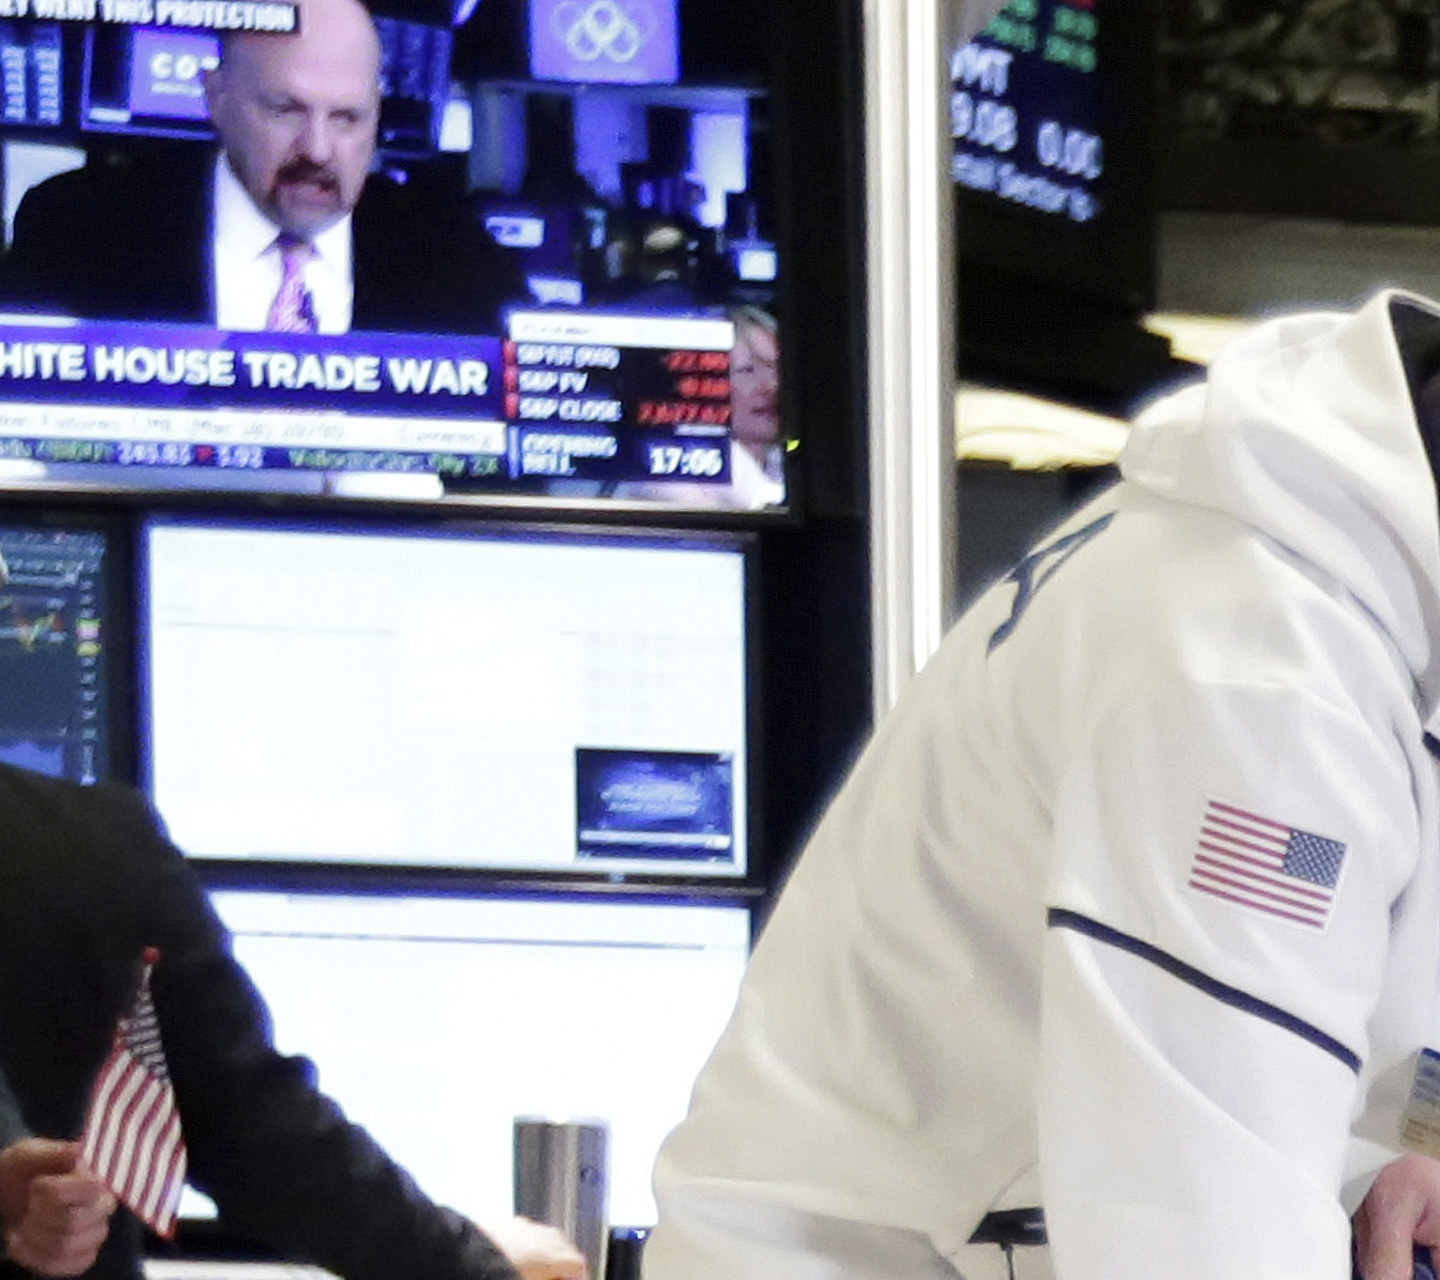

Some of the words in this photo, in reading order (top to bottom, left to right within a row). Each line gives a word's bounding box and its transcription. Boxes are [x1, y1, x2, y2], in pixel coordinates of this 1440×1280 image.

[95, 346, 236, 387] HOUSE
[243, 351, 381, 392] TRADE
[388, 358, 489, 396] WAR
